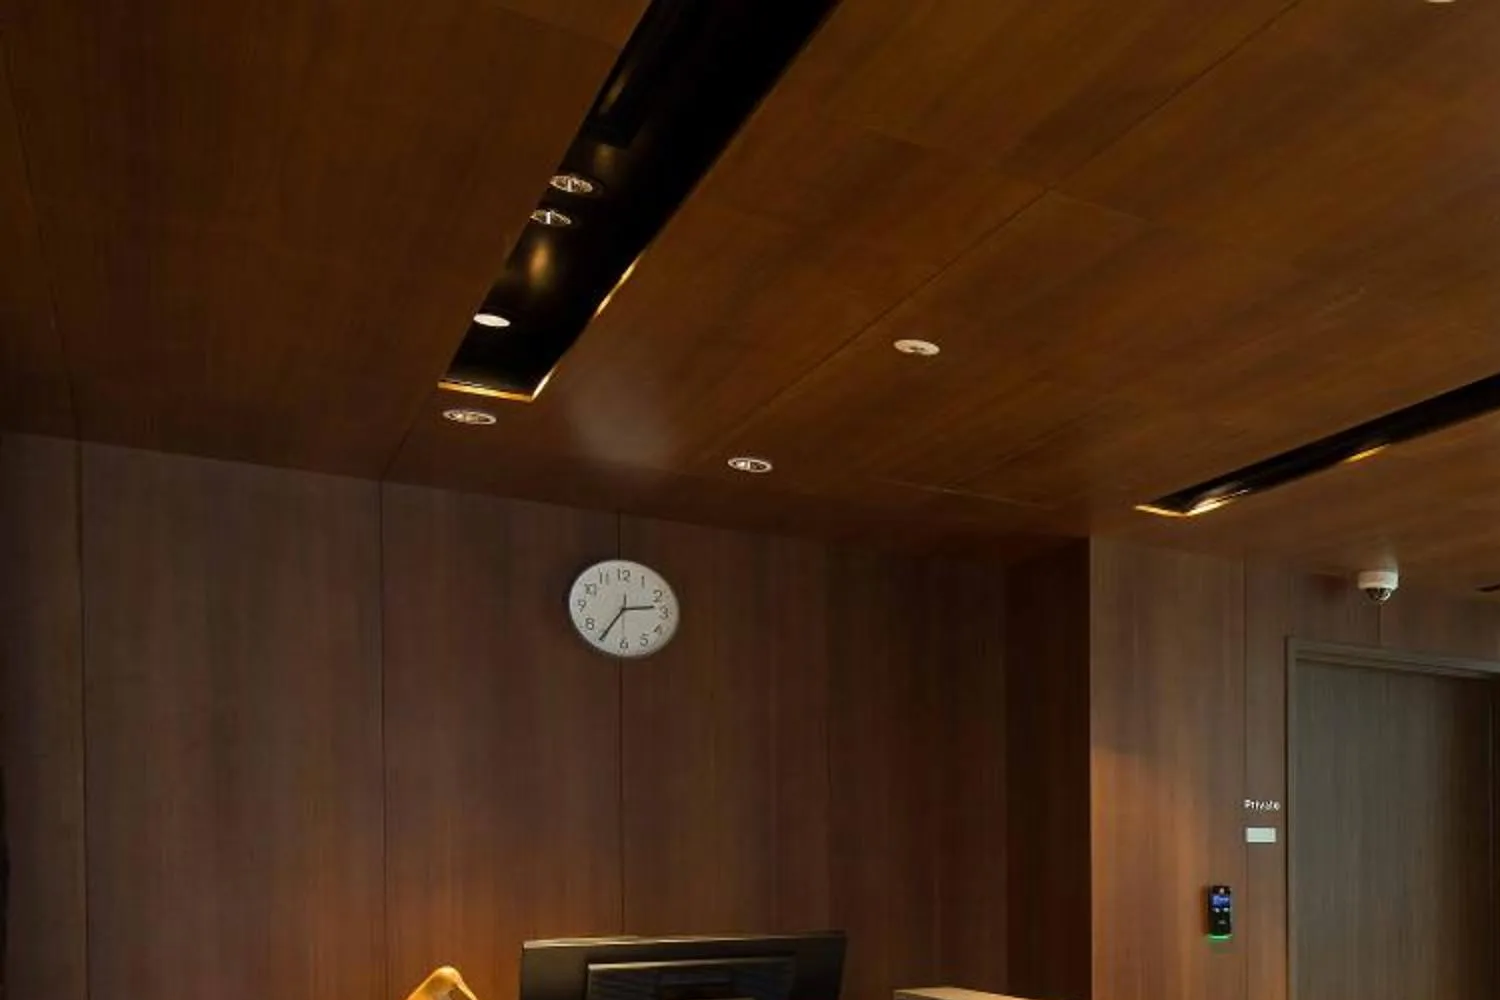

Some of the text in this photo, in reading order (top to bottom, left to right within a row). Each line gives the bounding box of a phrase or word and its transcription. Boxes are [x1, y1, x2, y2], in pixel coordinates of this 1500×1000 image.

[617, 568, 631, 582] 12
[652, 589, 662, 602] 2
[577, 599, 586, 612] 9
[659, 606, 670, 620] 3
[585, 618, 595, 630] 8
[619, 638, 629, 649] 6
[640, 633, 649, 647] 5
[1244, 799, 1281, 811] Private
